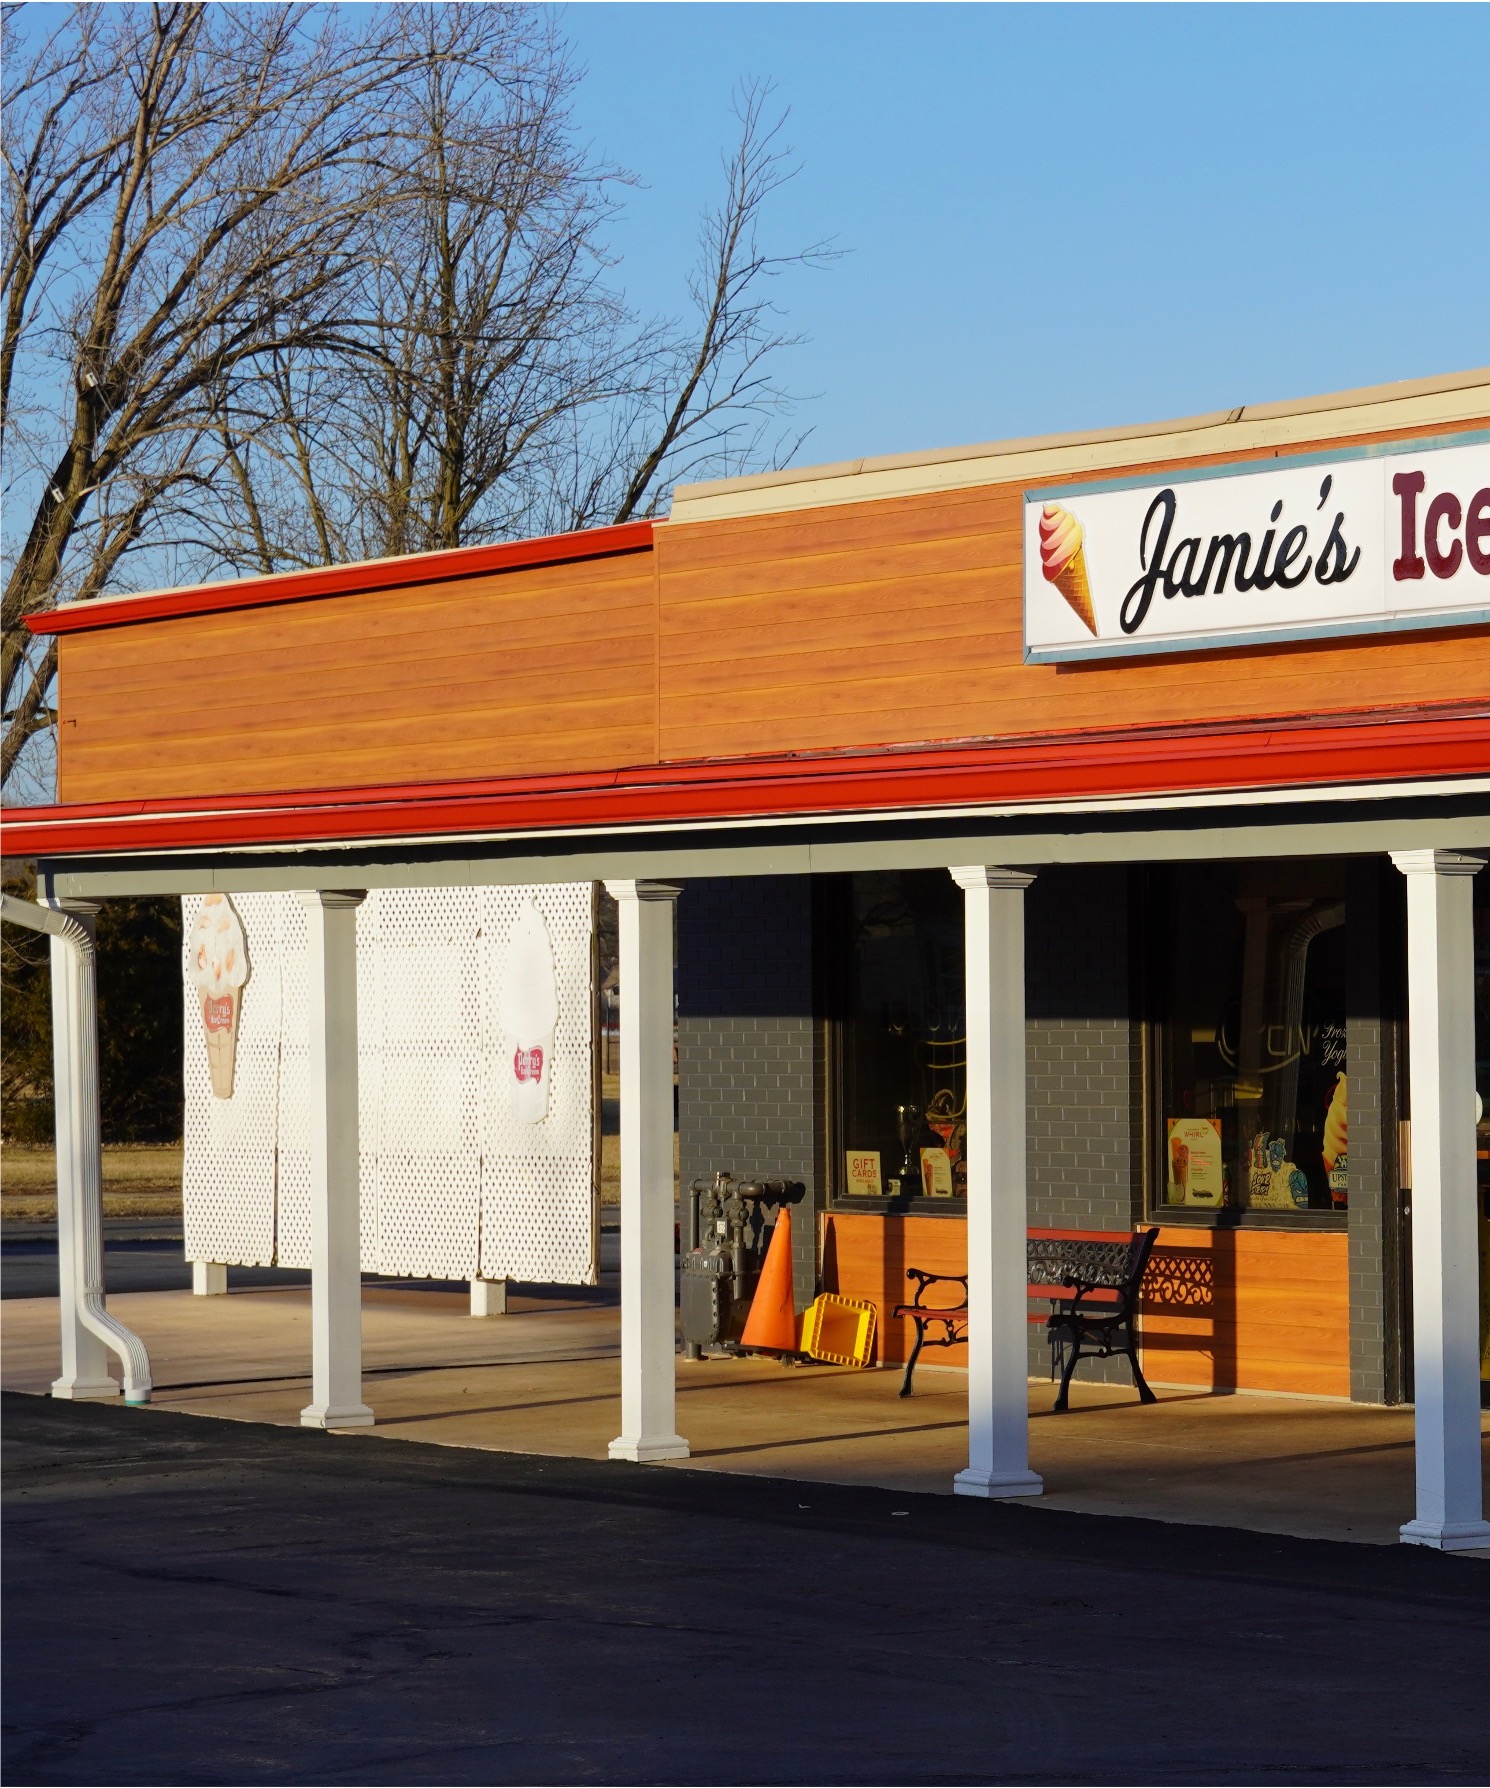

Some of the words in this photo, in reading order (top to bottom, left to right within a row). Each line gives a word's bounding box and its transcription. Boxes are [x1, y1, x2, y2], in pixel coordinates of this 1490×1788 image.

[1120, 474, 1362, 634] Jamie's
[852, 1158, 876, 1170] GIFT
[851, 1169, 877, 1178] CARDS
